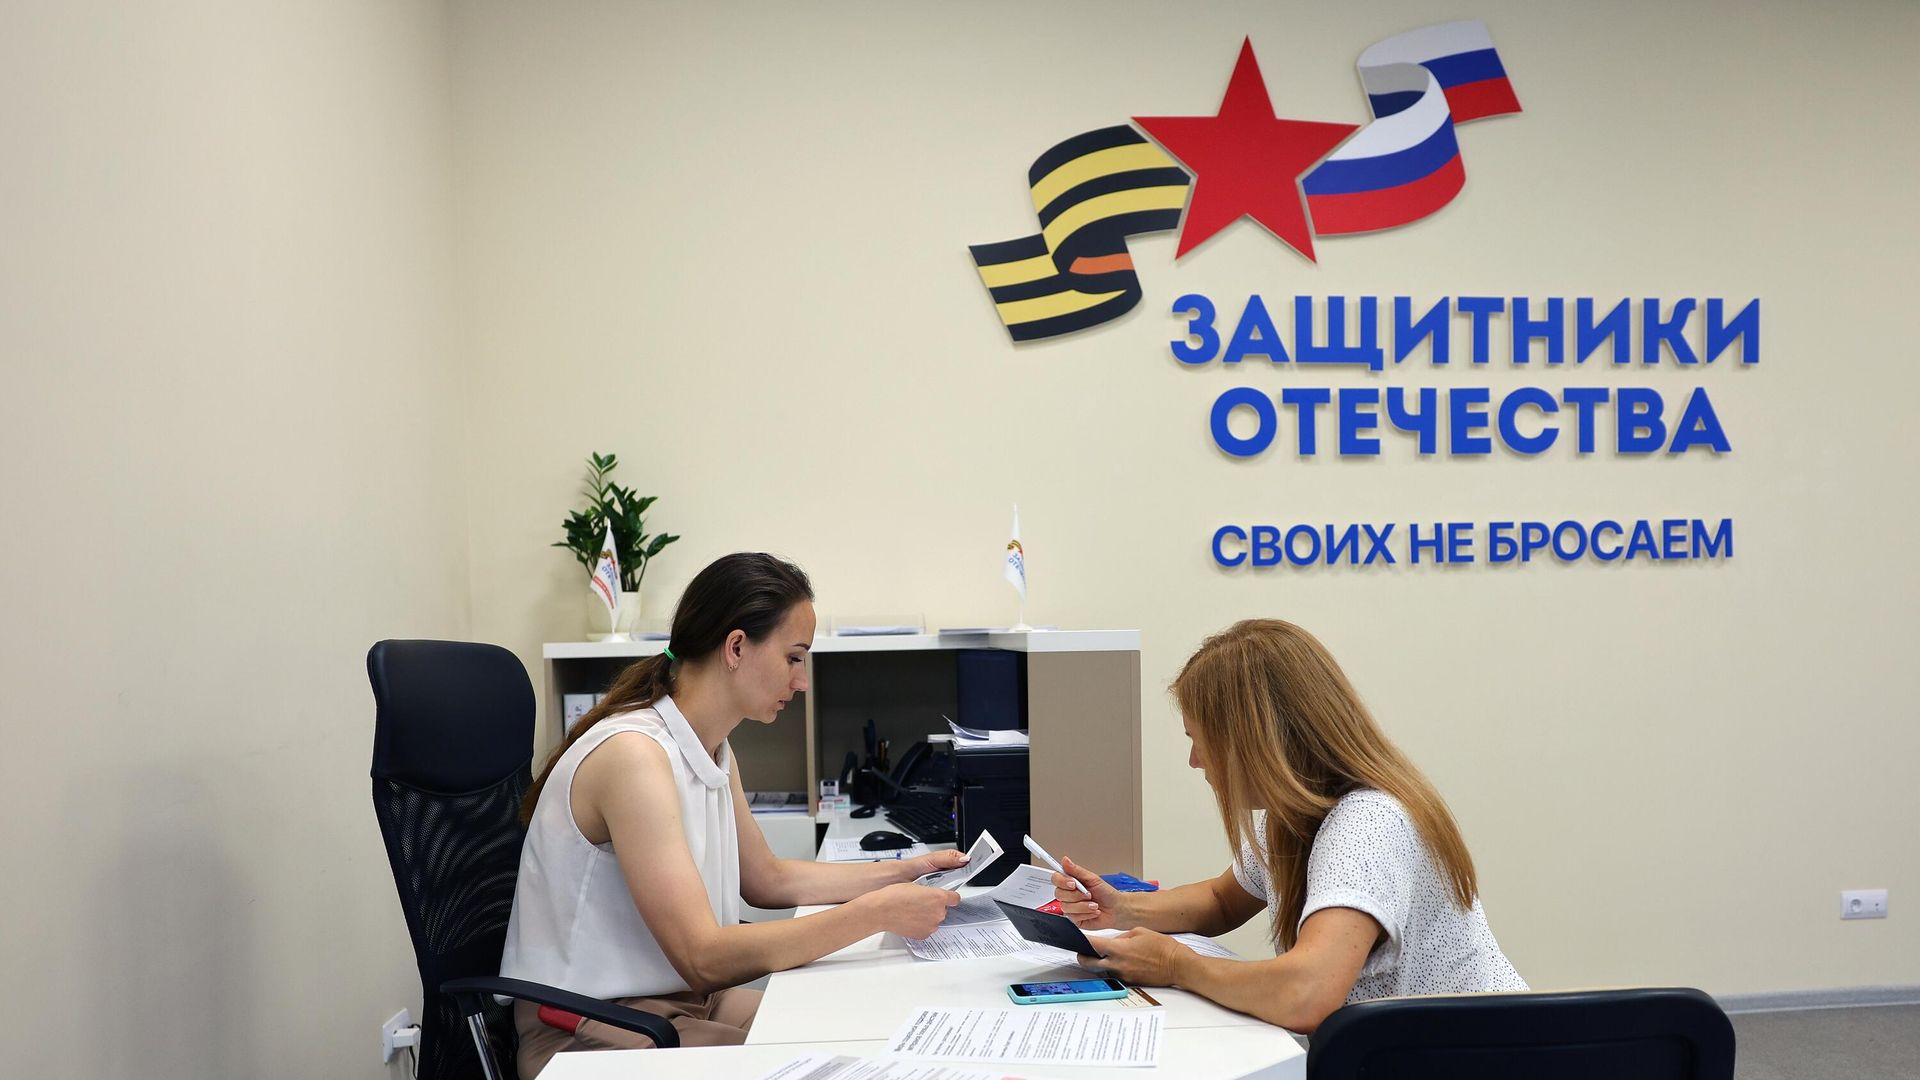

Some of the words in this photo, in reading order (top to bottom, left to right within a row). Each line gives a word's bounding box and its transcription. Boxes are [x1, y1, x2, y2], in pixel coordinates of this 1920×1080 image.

[1171, 294, 1760, 371] ЗАЩИТНИКИ
[1210, 387, 1732, 457] ОТЕЧЕСТВА
[1212, 524, 1396, 567] СВОИХ
[1410, 522, 1475, 564] НЕ
[1489, 519, 1733, 563] БРОСАЕМ
